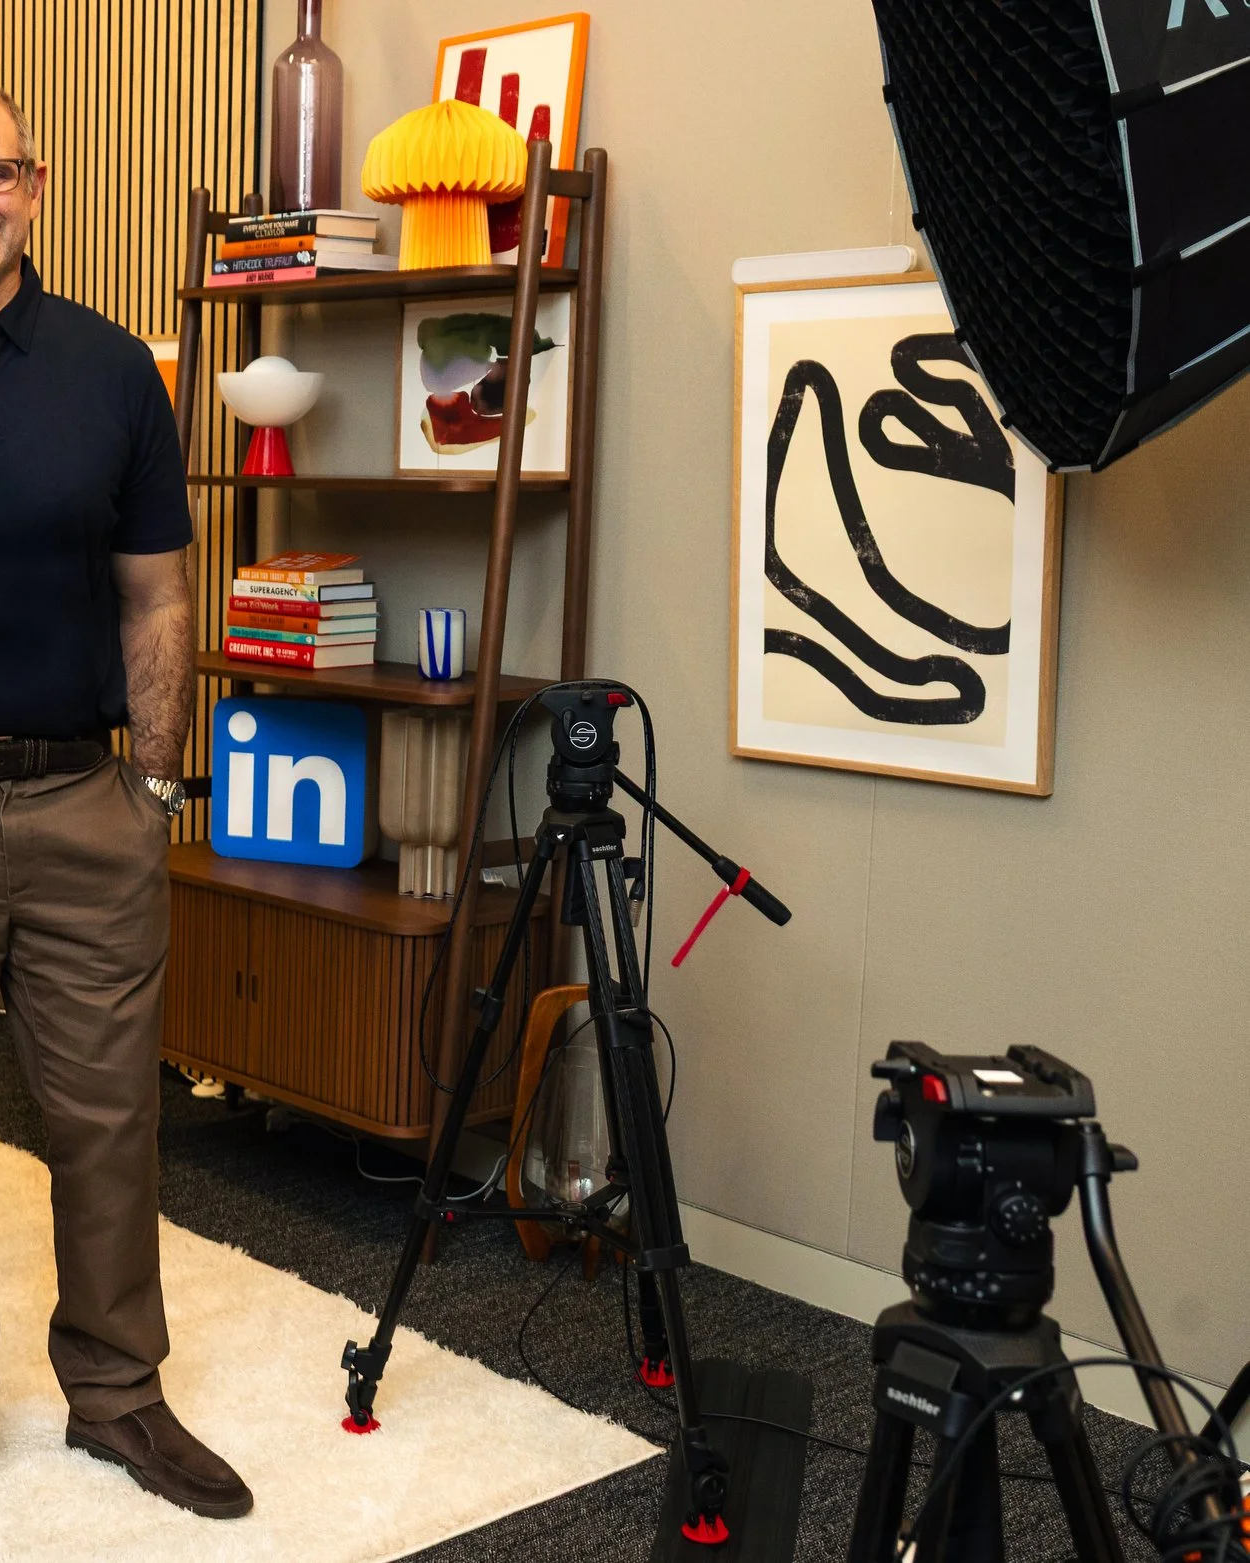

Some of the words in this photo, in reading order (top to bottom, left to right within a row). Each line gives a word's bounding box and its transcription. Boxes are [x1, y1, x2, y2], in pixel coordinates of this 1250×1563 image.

[232, 258, 262, 271] HITCHCOCK
[250, 585, 298, 597] SUPERAGENCY
[229, 642, 262, 657] CREATIVITY,
[263, 647, 275, 657] INC.
[228, 711, 346, 846] in
[592, 844, 617, 852] sachtler
[887, 1387, 941, 1417] sachtler
